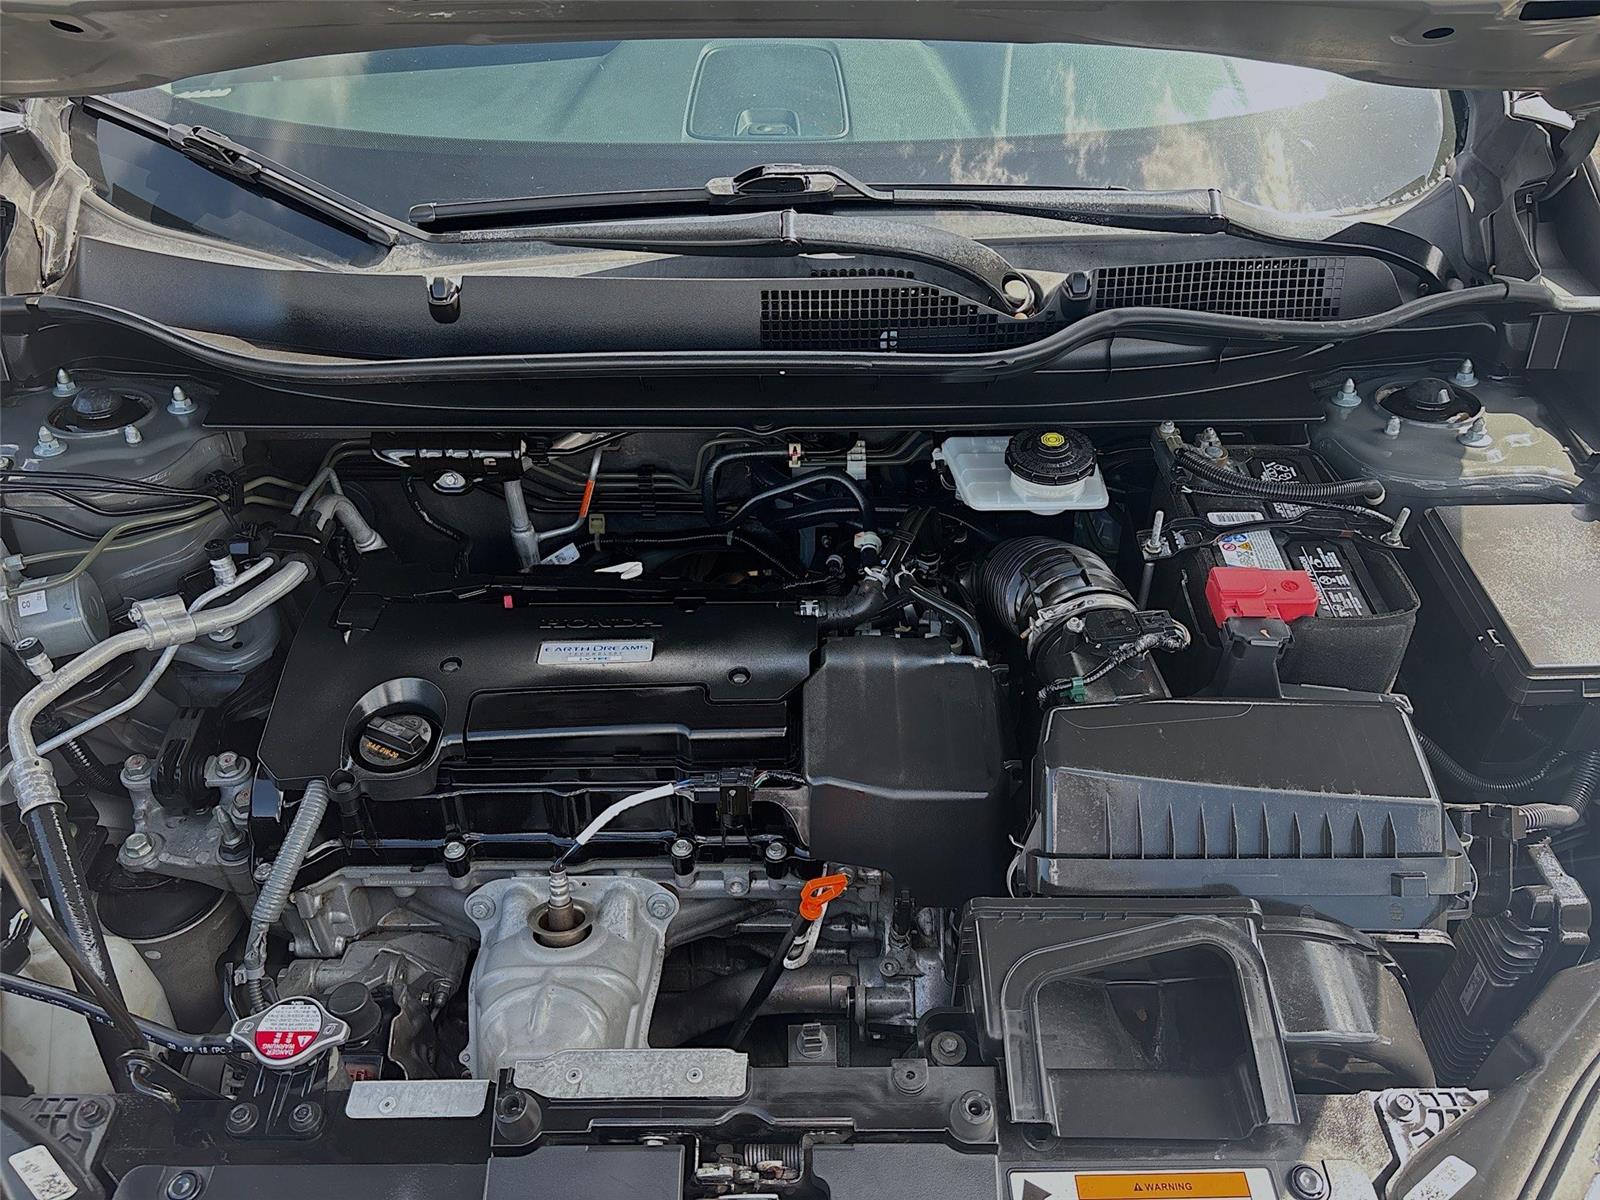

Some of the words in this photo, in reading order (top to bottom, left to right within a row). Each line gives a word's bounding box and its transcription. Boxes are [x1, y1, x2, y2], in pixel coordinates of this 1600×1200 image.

[539, 618, 663, 629] HONDA
[545, 645, 590, 653] EARTH
[593, 644, 649, 652] DREAMS
[198, 1046, 208, 1054] 18
[1144, 1182, 1193, 1191] WARNING
